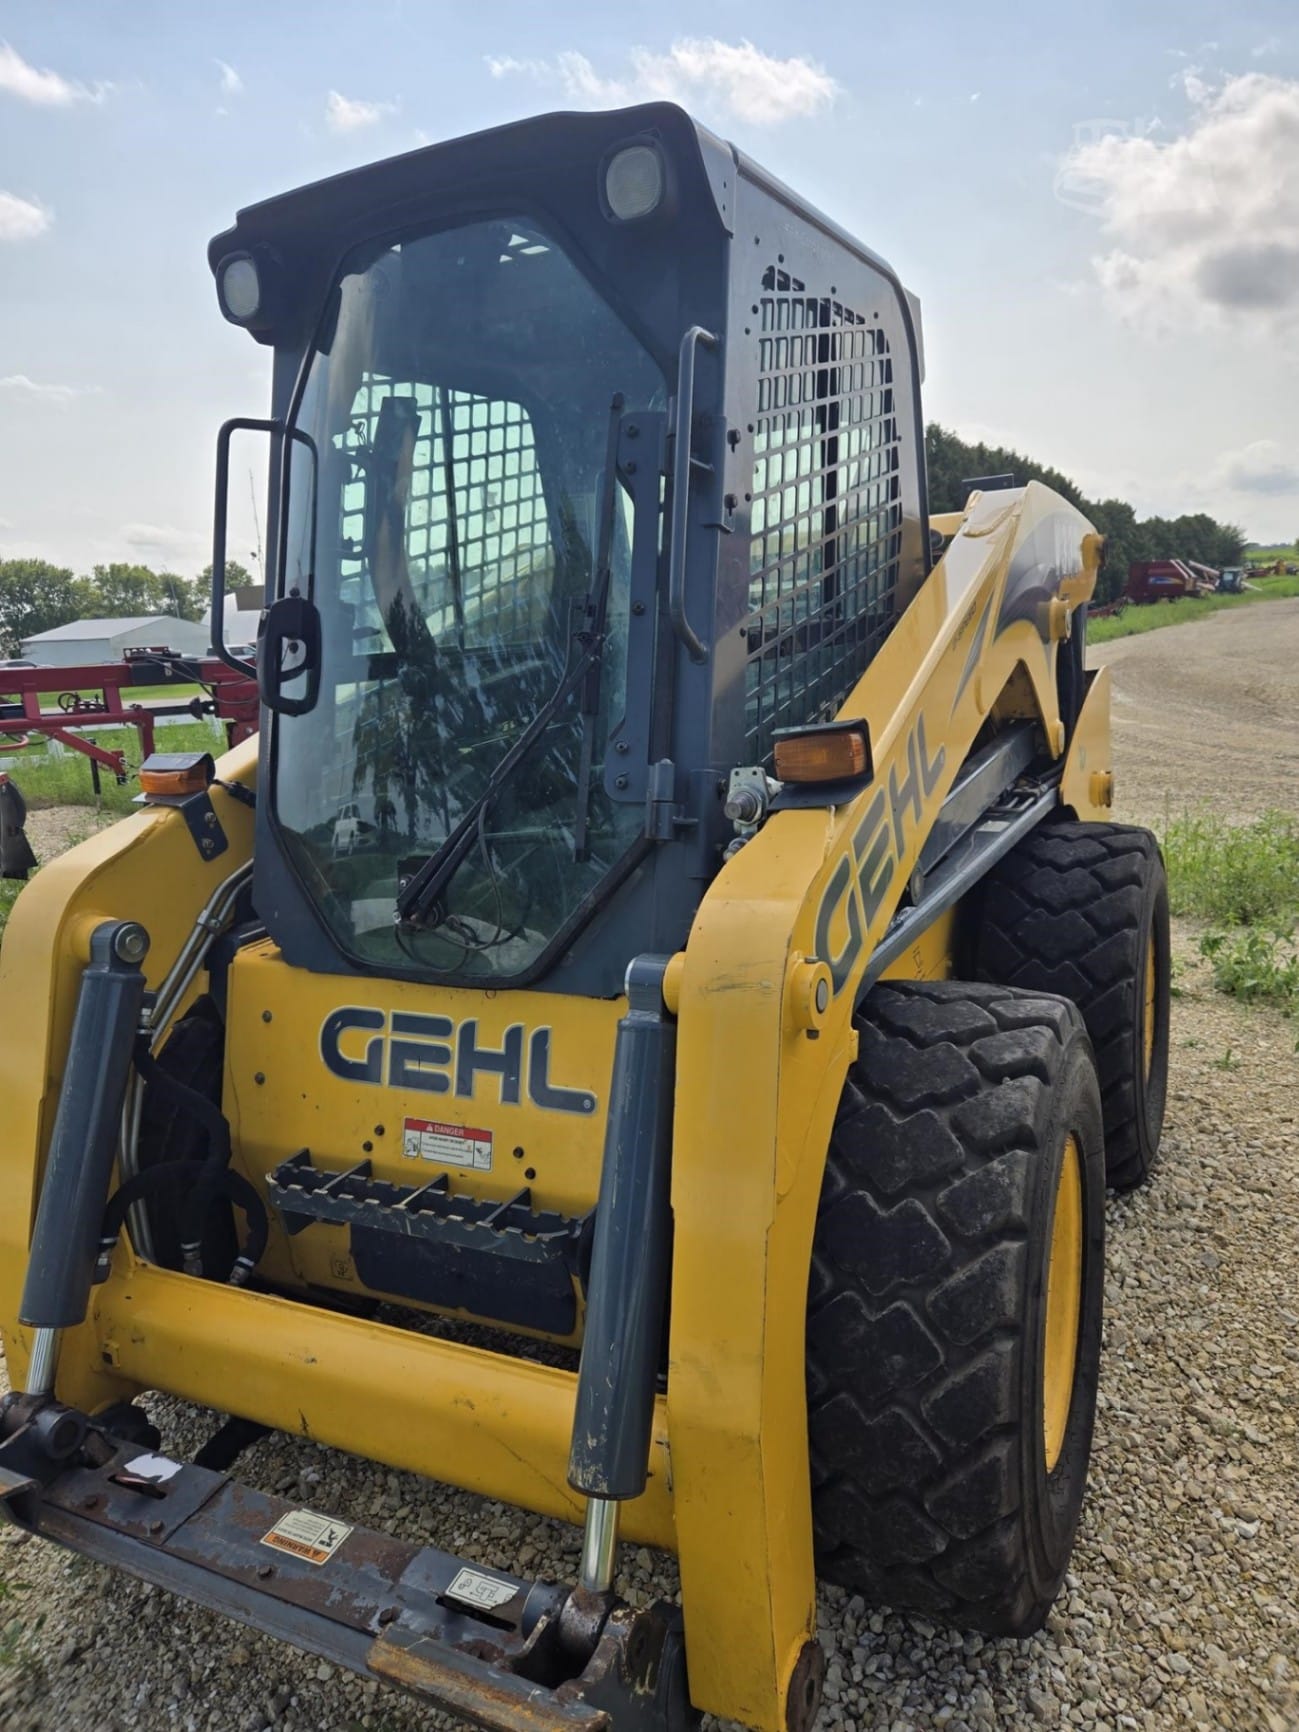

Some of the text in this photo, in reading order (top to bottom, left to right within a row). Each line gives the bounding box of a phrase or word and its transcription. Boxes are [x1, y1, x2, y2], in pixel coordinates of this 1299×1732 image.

[814, 710, 946, 997] GEHL
[319, 1004, 597, 1115] GEHL
[434, 1124, 465, 1136] DANGER
[271, 1536, 311, 1555] WARNING
